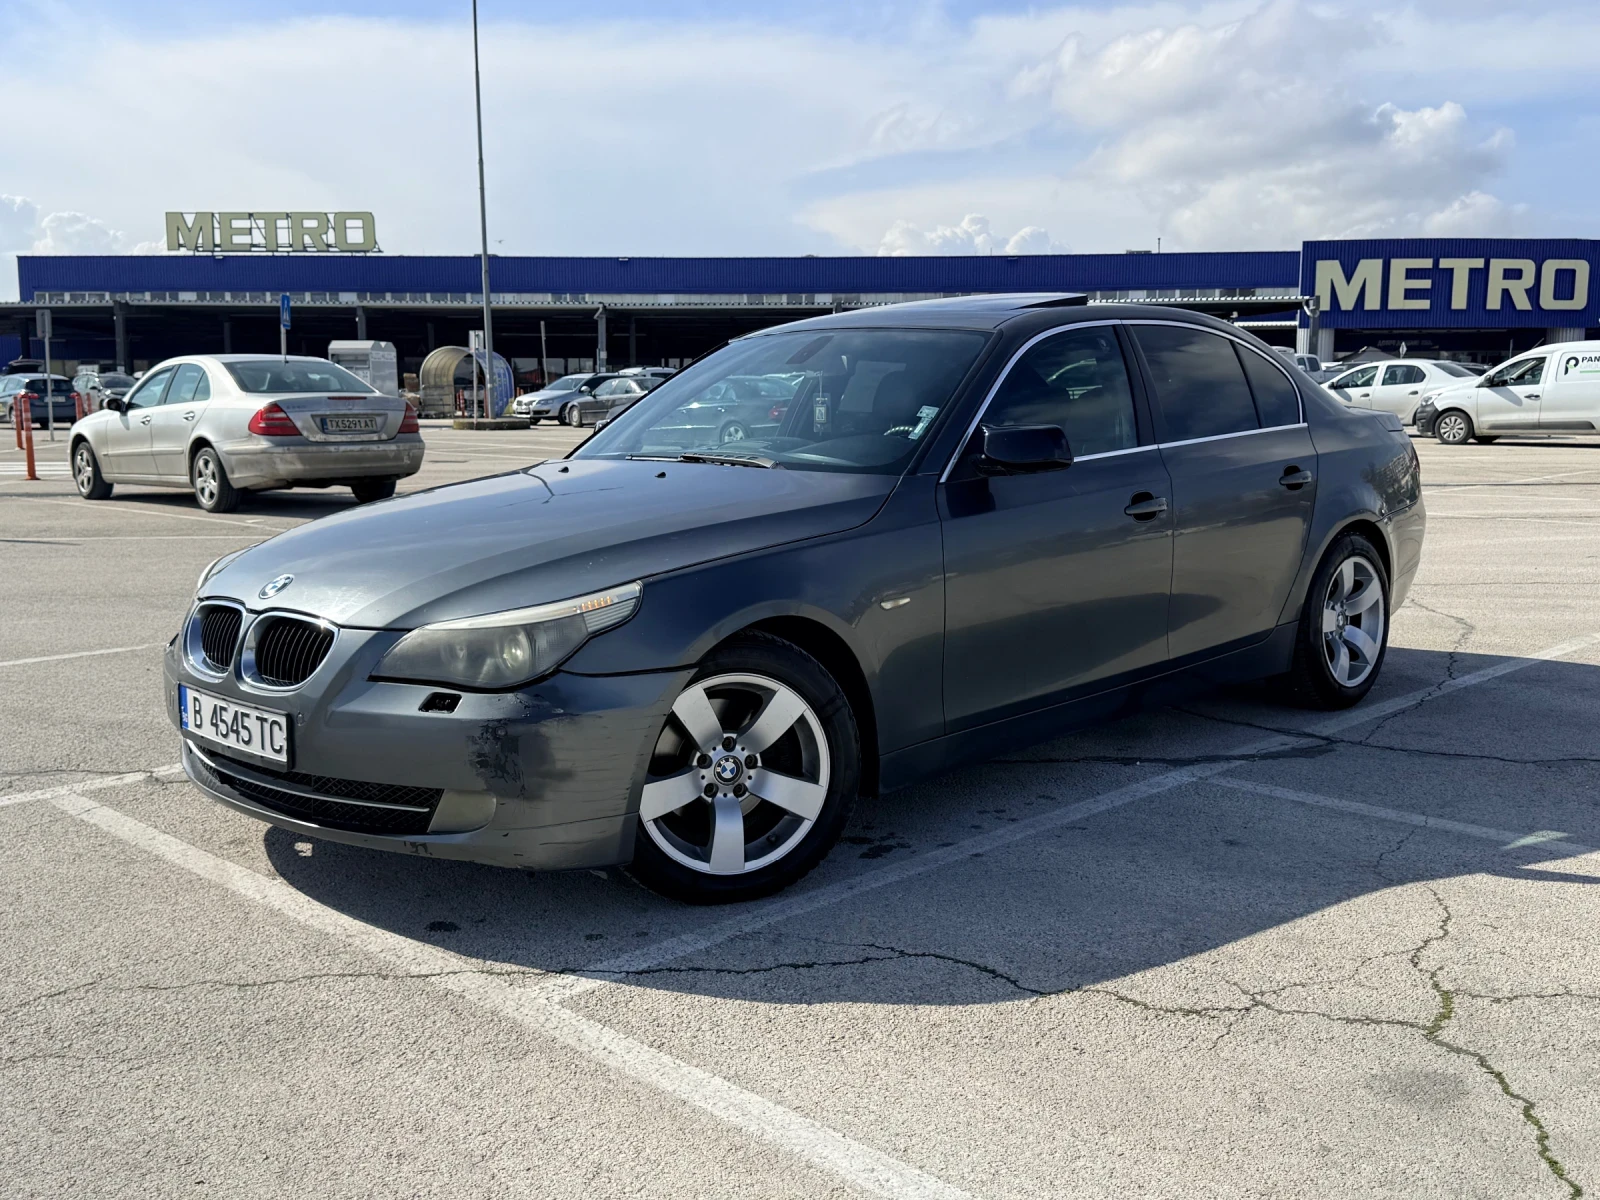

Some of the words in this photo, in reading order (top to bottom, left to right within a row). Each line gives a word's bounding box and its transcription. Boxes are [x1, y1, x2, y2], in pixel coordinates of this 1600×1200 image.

[165, 212, 376, 251] METRO
[1315, 258, 1590, 311] METRO
[193, 696, 203, 729] B
[210, 703, 252, 746] 4545
[256, 715, 283, 754] TC
